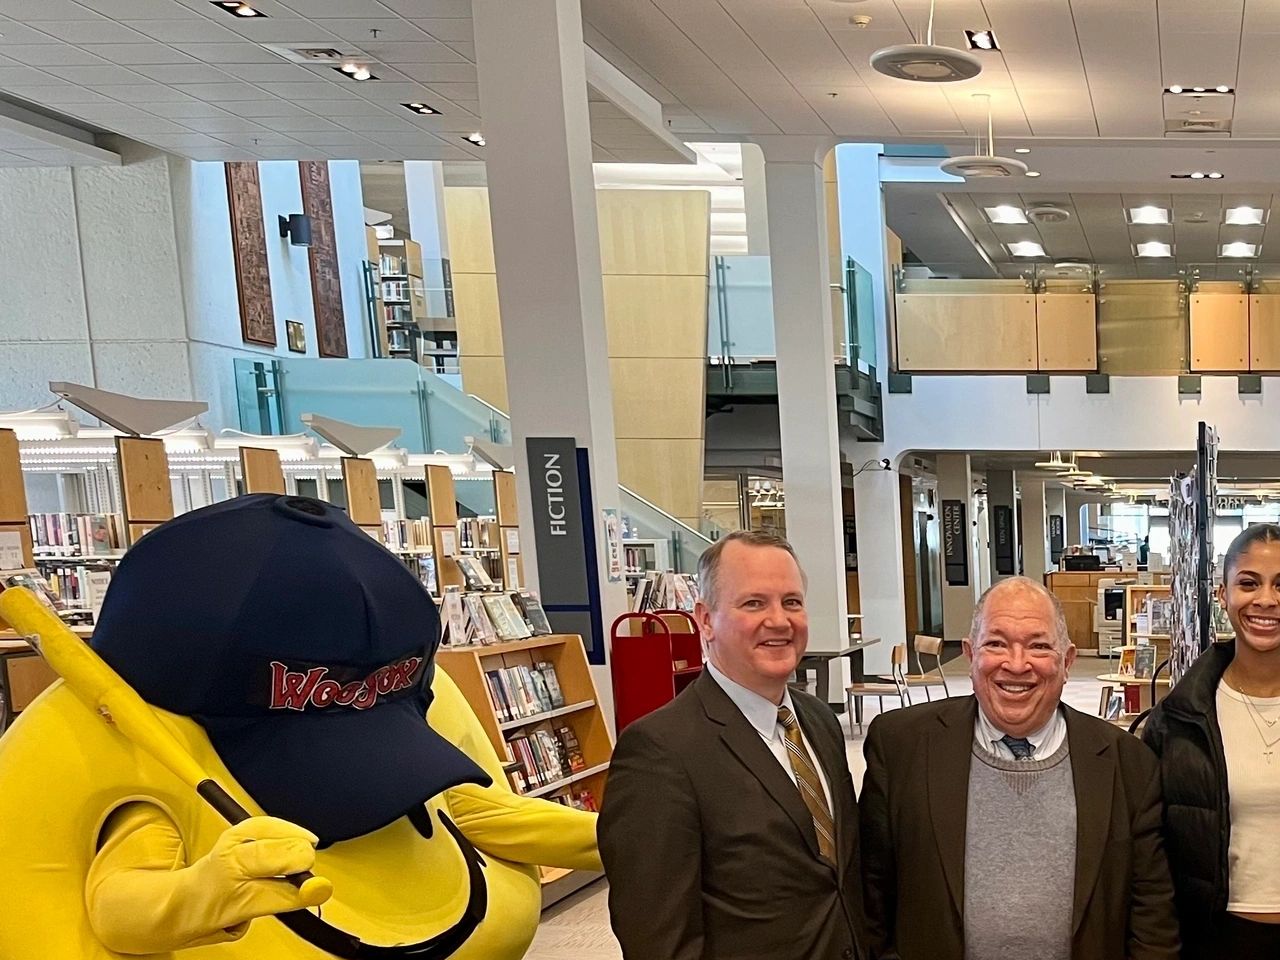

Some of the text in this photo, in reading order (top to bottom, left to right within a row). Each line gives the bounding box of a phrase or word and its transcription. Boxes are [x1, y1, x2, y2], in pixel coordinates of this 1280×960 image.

[544, 454, 567, 535] FICTION
[953, 505, 961, 535] CENTER
[944, 505, 953, 556] INNOVATION
